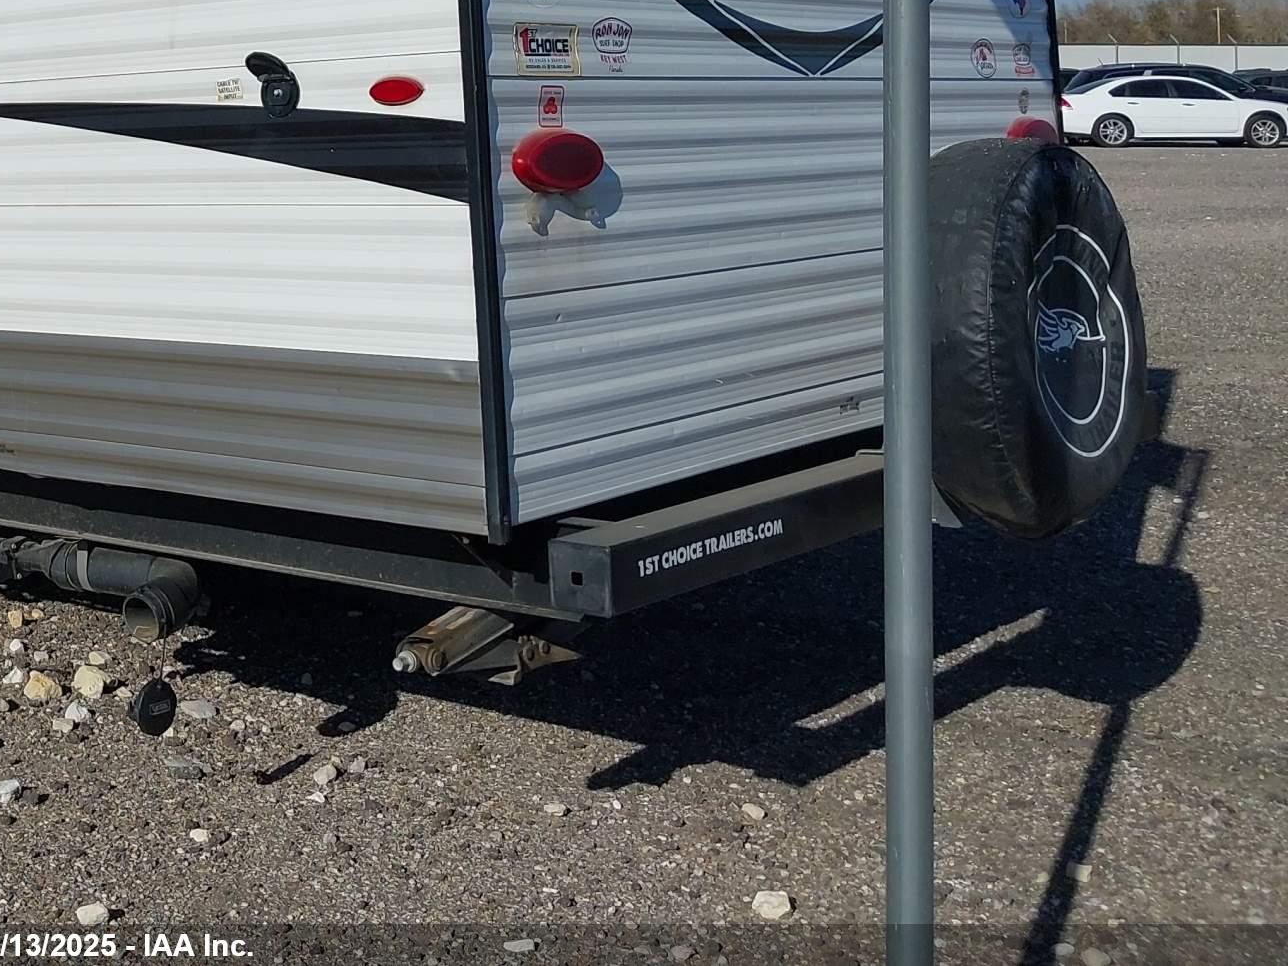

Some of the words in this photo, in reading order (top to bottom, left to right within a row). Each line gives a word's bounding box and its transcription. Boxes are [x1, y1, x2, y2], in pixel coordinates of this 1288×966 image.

[595, 22, 613, 40] RON
[613, 23, 630, 40] JON
[529, 38, 569, 53] CHOICE
[600, 54, 611, 64] KEY
[612, 54, 627, 64] WEST
[218, 86, 241, 94] SATELLITE
[638, 554, 660, 578] 1ST
[662, 541, 703, 569] CHOICE
[705, 519, 784, 555] TRAILERS.COM
